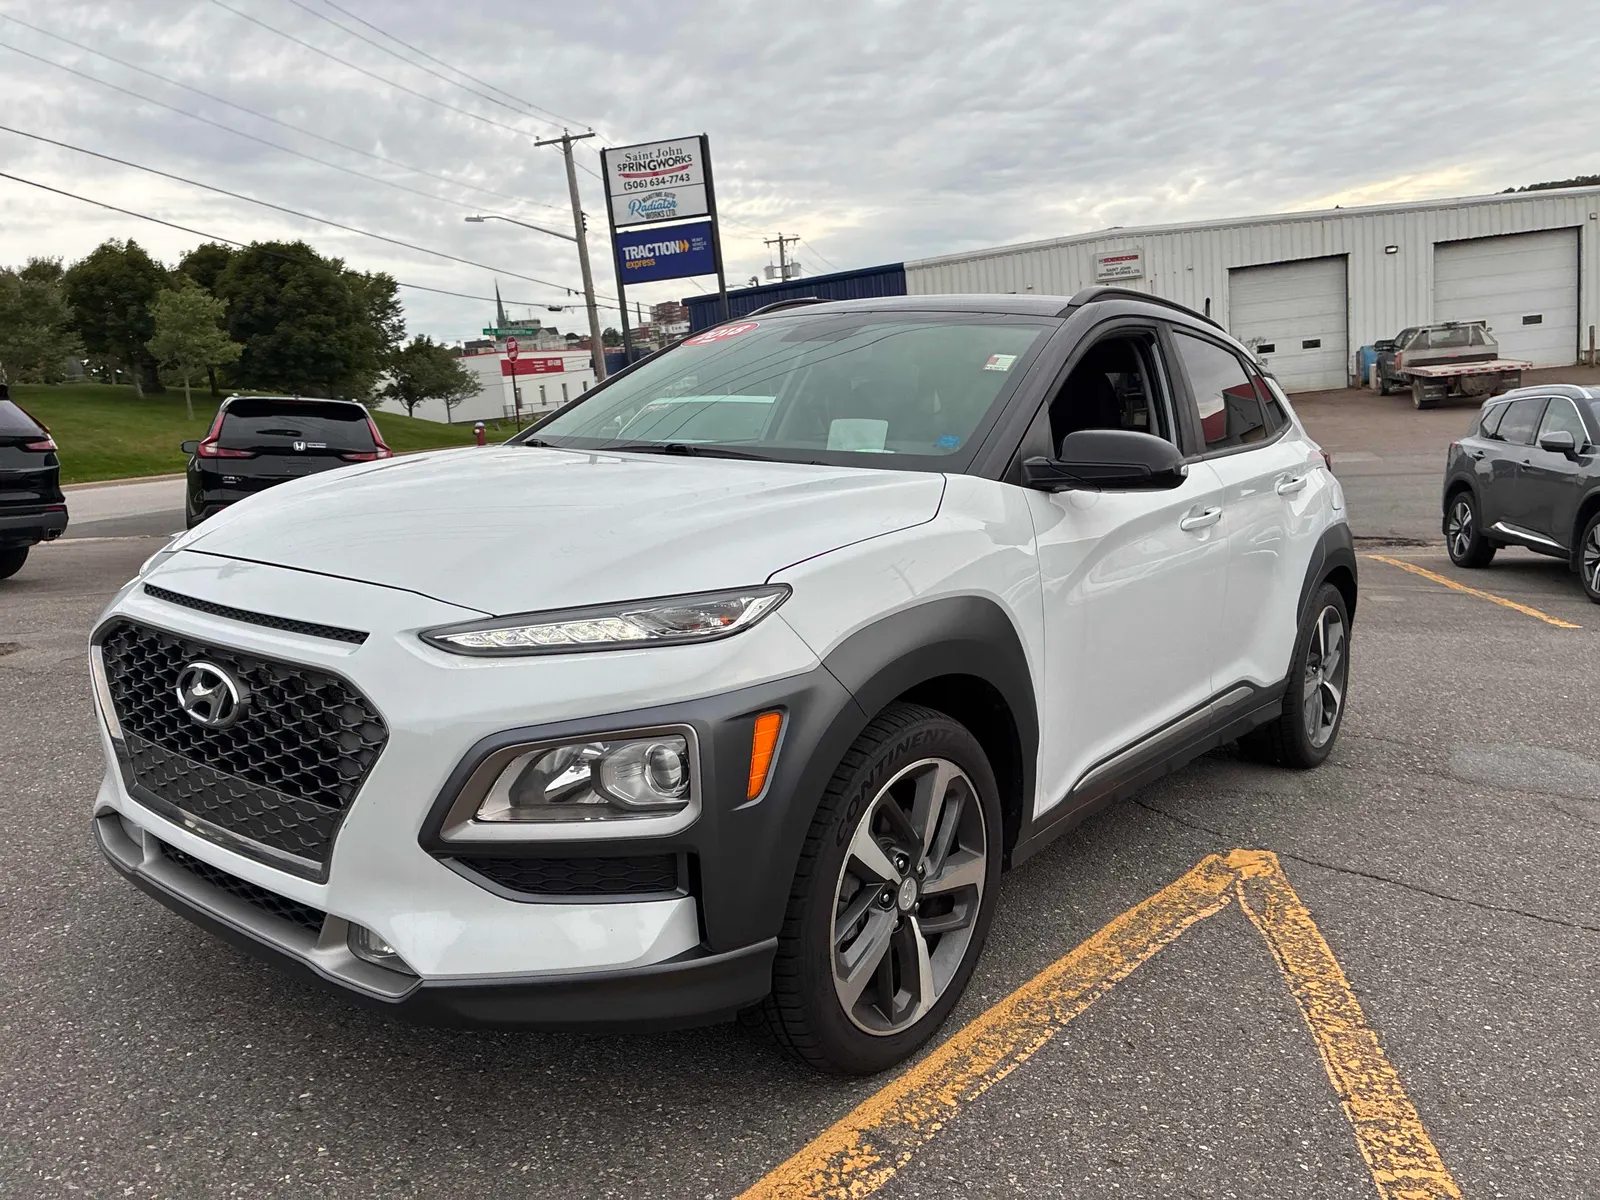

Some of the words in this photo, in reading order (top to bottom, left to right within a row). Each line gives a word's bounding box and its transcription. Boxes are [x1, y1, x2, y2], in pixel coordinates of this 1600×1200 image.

[625, 151, 653, 162] Saint
[656, 147, 683, 158] John
[617, 154, 692, 172] SPRINGWORKS
[624, 178, 648, 191] (506)
[650, 173, 690, 187] 634-7743
[663, 191, 676, 199] AUTO
[628, 198, 678, 217] Radiator
[645, 211, 665, 220] WORKS
[623, 240, 680, 260] TRACTION
[626, 258, 656, 269] express
